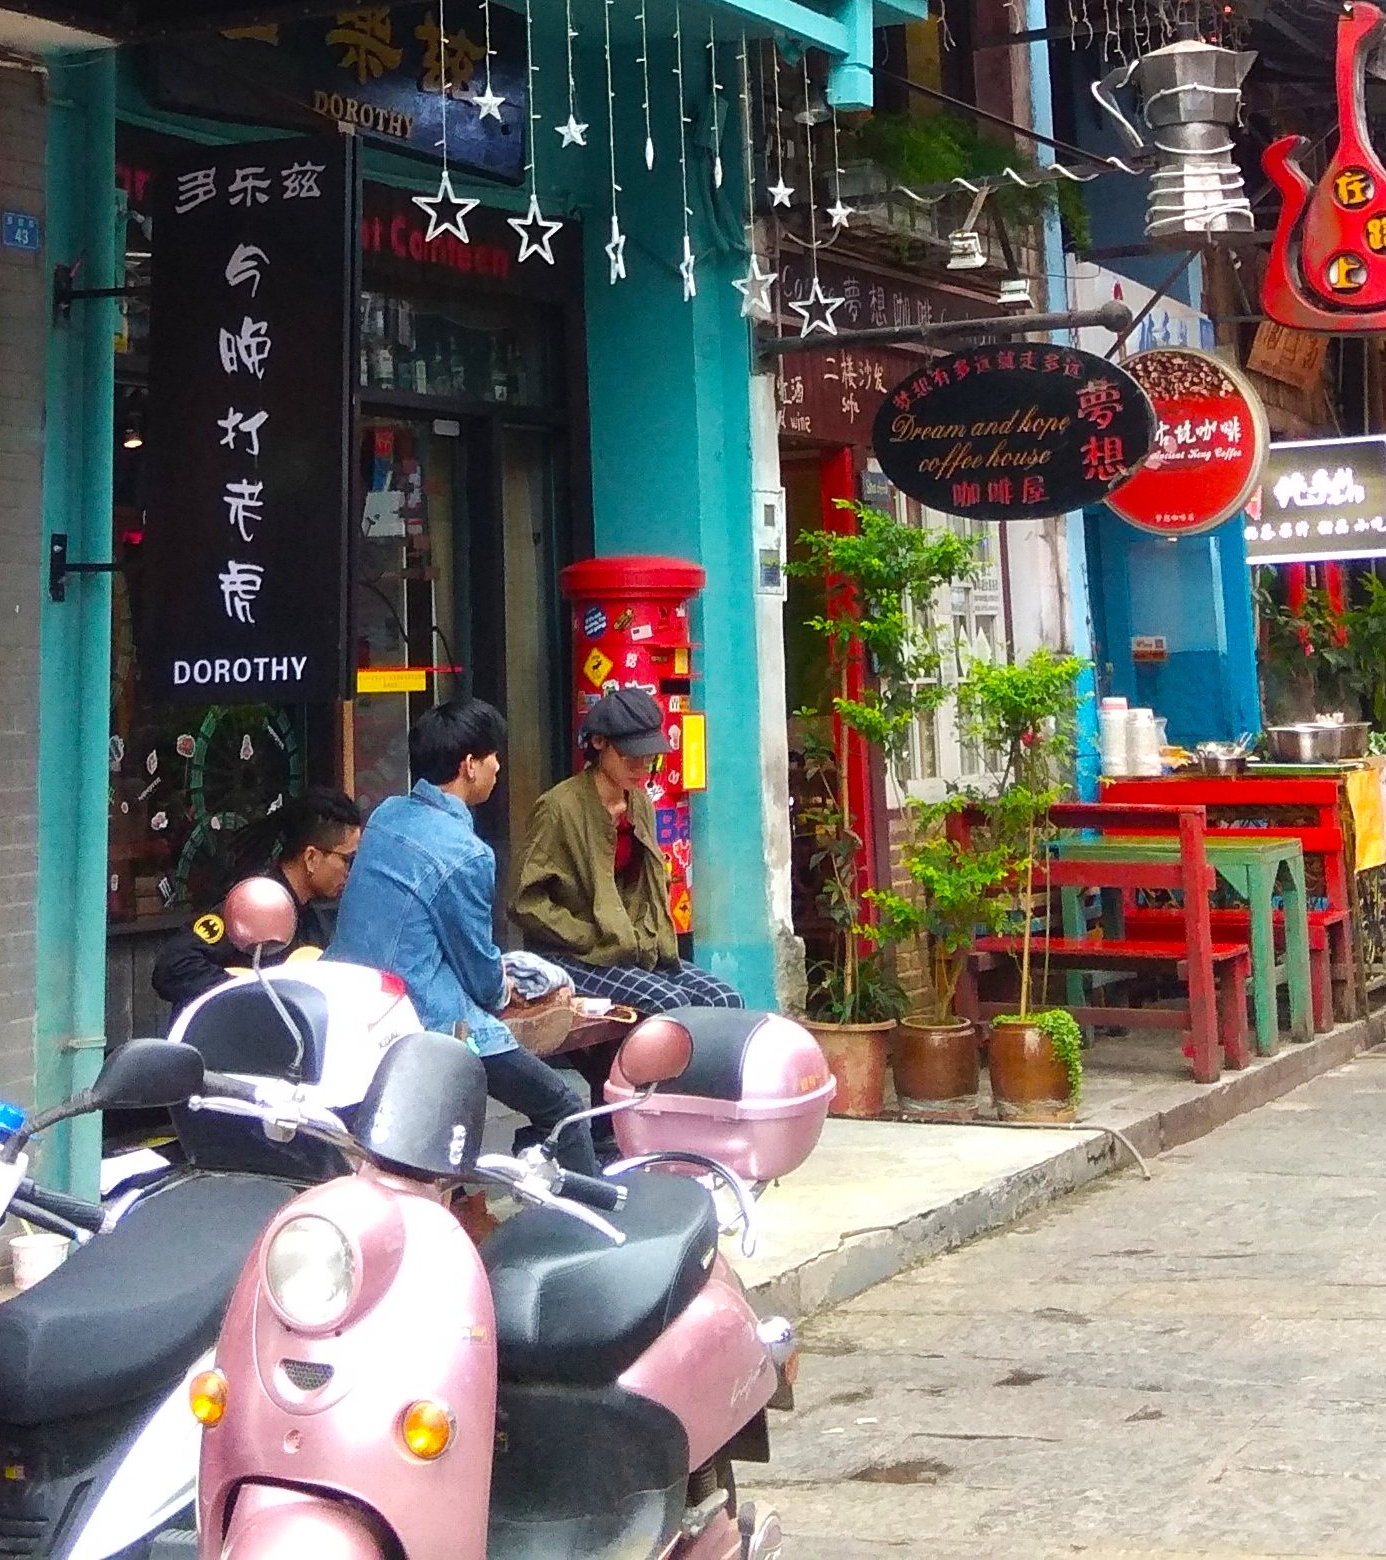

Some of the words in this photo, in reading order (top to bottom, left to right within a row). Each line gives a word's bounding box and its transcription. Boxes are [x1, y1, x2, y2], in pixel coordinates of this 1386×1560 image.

[312, 90, 414, 138] DOROTHY
[174, 160, 326, 214] 多乐兹
[15, 228, 29, 244] 43
[217, 243, 273, 624] 今晚打老虎
[889, 414, 963, 442] Dream
[970, 409, 1021, 436] and
[1017, 405, 1071, 440] hope
[1075, 379, 1131, 483] 夢想
[918, 441, 984, 480] coffee
[984, 439, 1054, 470] house
[1214, 447, 1242, 460] Coffee
[952, 475, 1050, 507] 咖啡屋
[173, 655, 307, 686] DOROTHY
